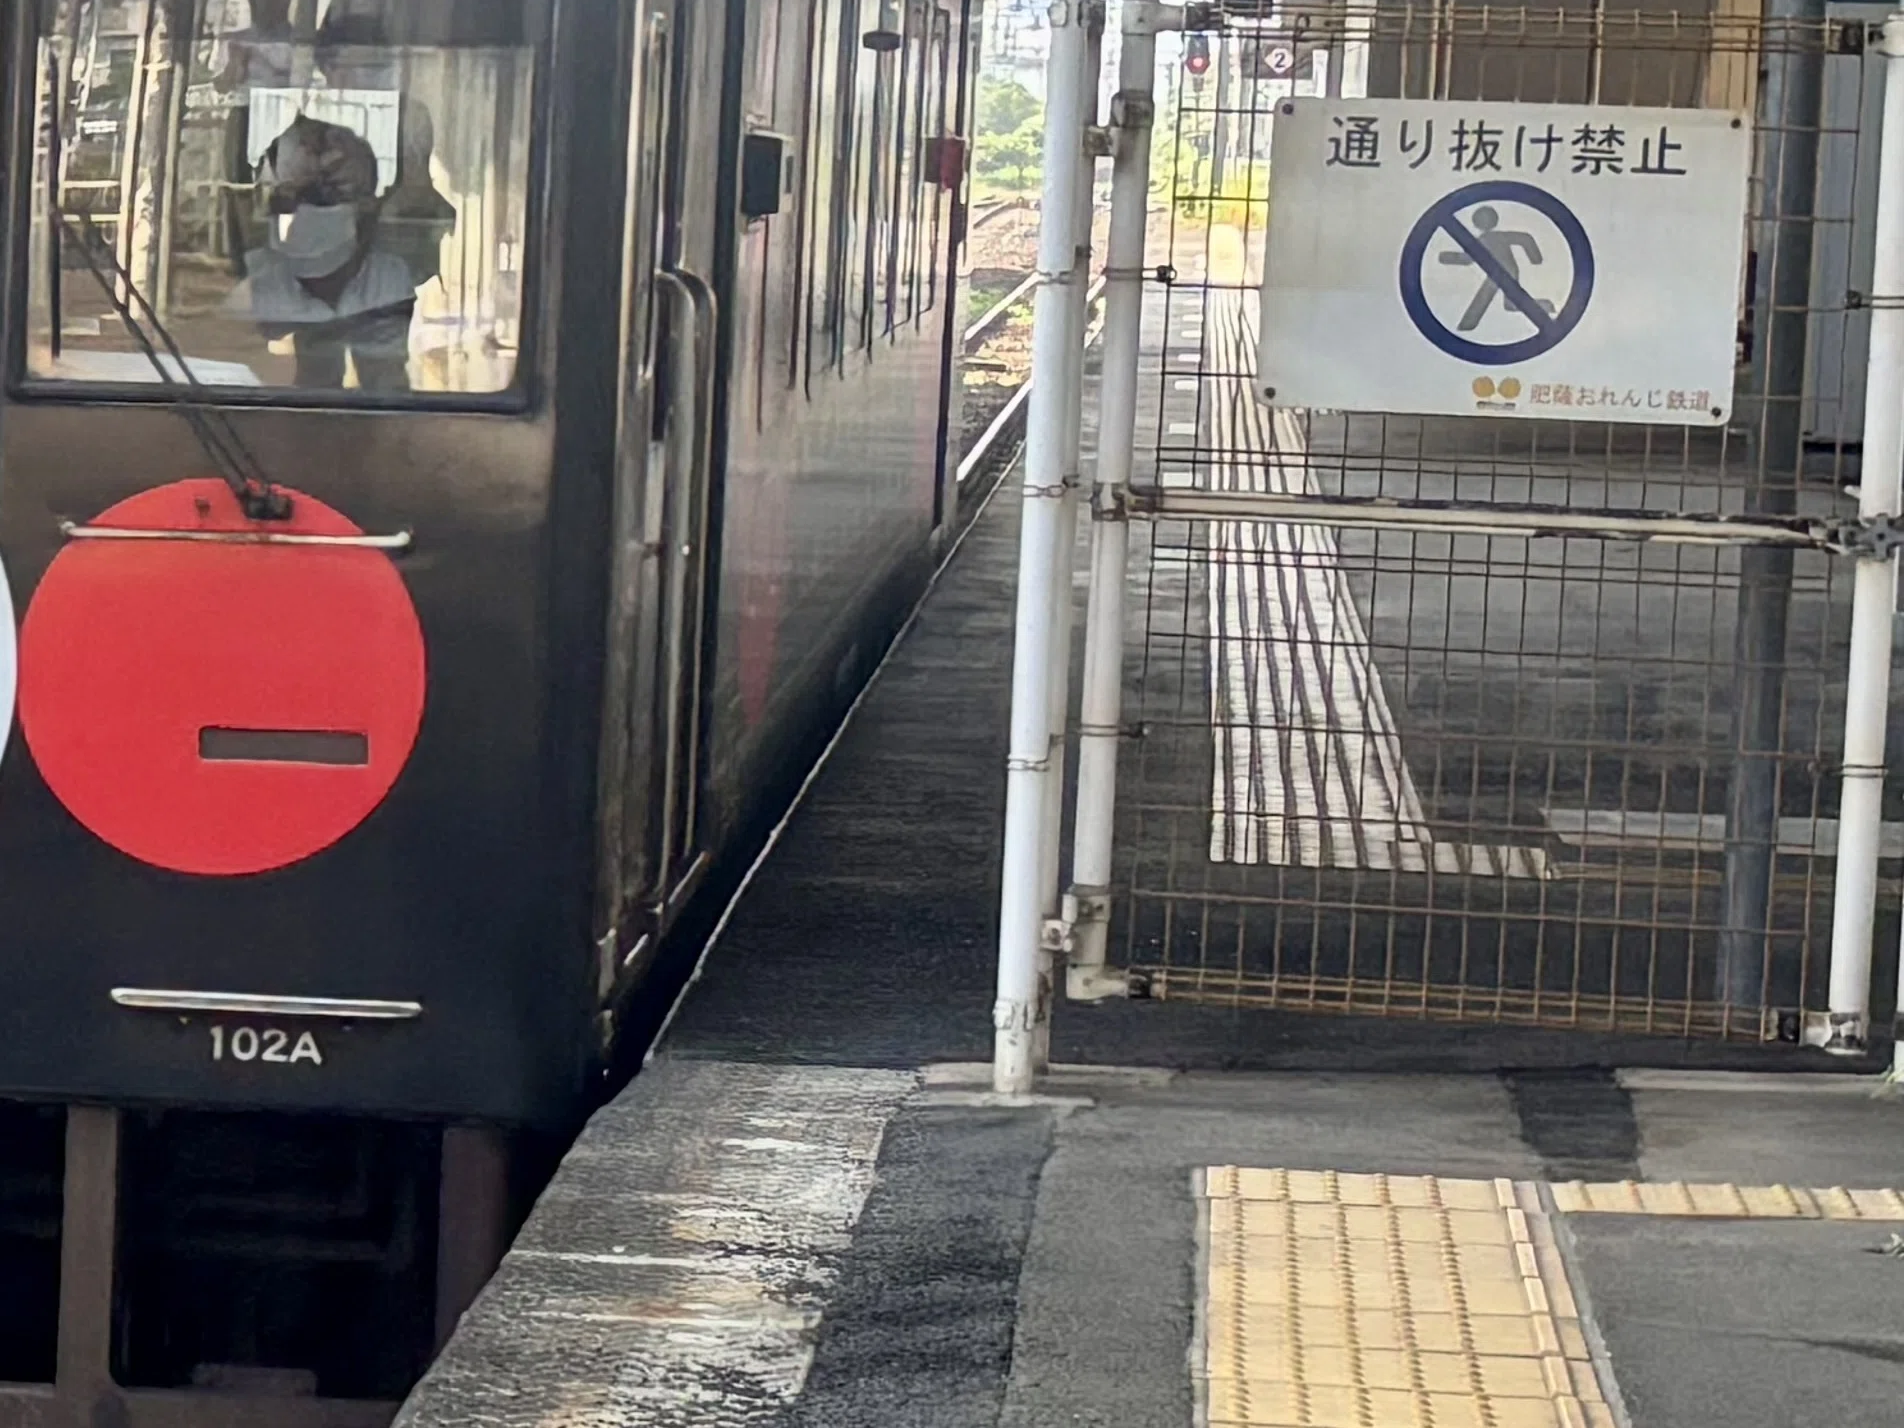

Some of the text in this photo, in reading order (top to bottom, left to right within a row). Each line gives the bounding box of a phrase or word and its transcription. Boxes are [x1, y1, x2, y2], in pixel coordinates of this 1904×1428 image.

[1274, 52, 1286, 69] 2
[1326, 116, 1688, 175] 通り抜け禁止
[1530, 382, 1711, 412] 肥薩おれんじ鉄道
[210, 1026, 323, 1065] 102A
